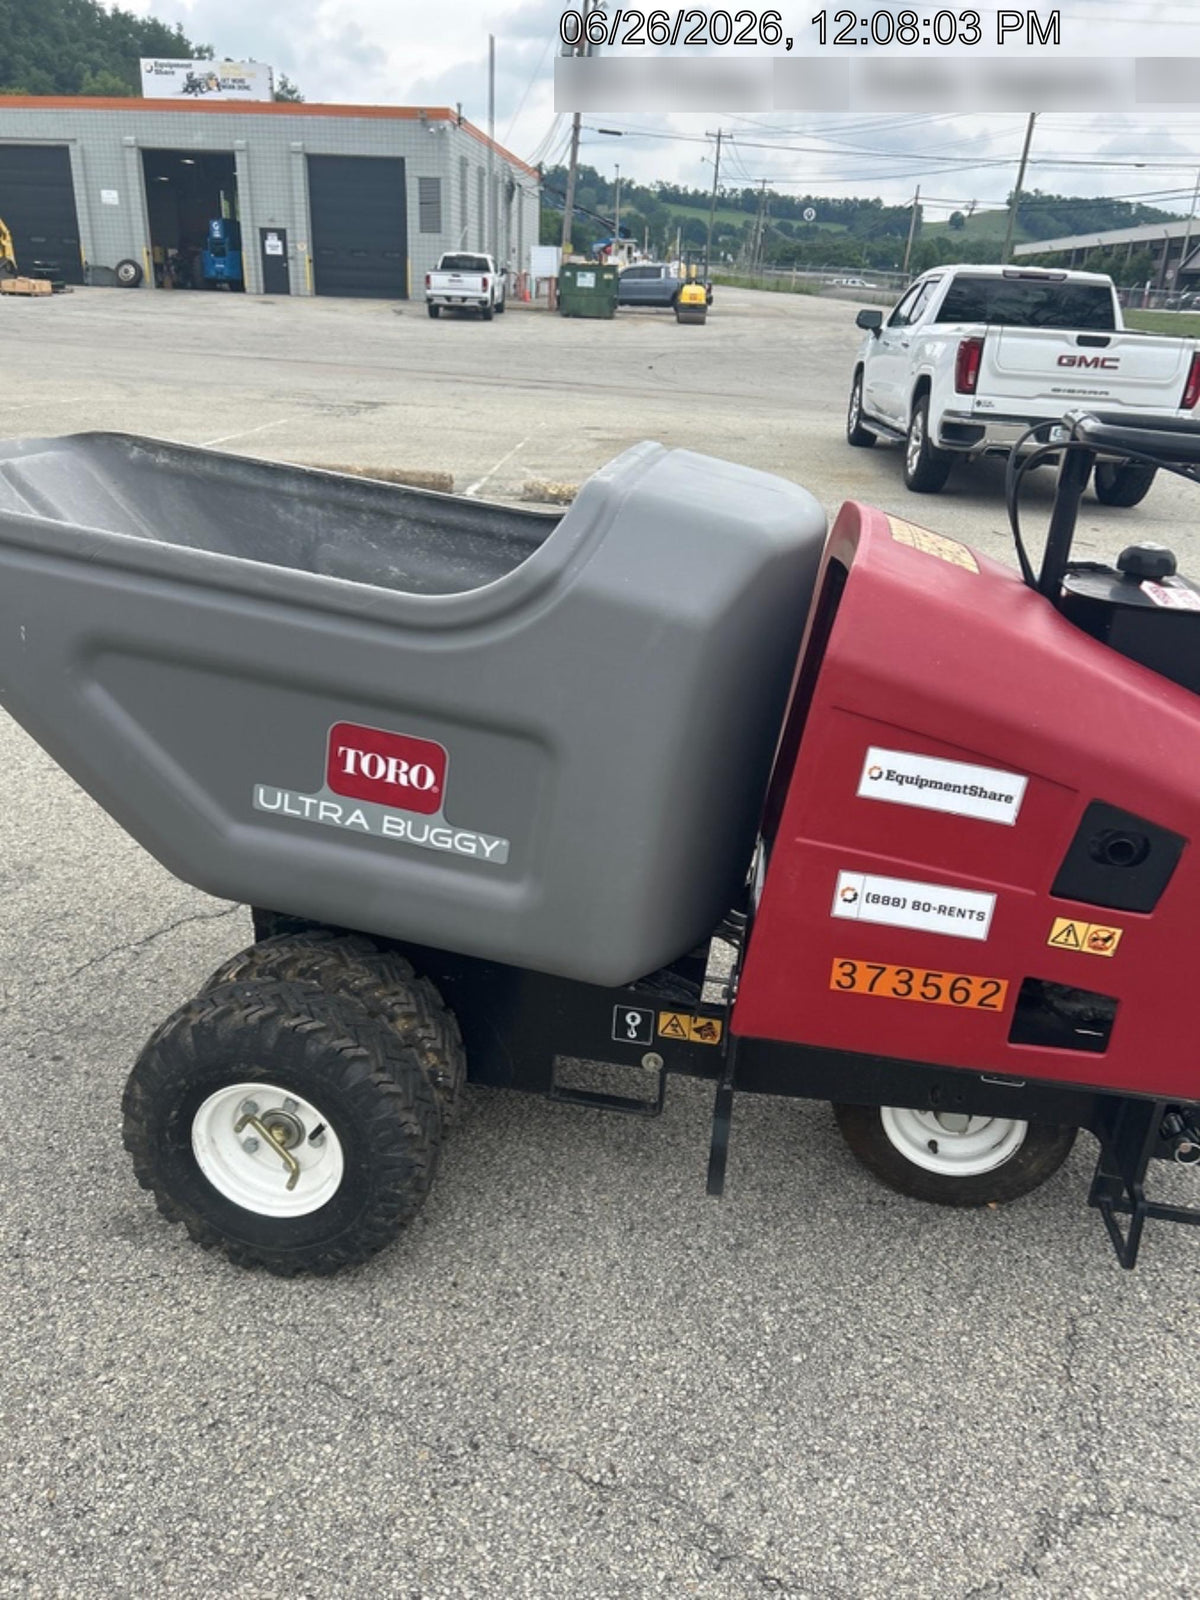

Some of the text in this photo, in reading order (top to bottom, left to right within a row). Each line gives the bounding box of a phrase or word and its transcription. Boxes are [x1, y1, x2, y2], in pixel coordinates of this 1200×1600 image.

[154, 61, 193, 69] Equipment
[1057, 354, 1121, 370] GMC
[1051, 387, 1110, 396] SIERRA
[337, 745, 437, 792] TORO
[885, 768, 1015, 806] EquipmentShare
[257, 788, 501, 858] ULTRA BUGGY
[864, 890, 986, 922] (888) 80-RENTS
[834, 960, 1004, 1009] 373562
